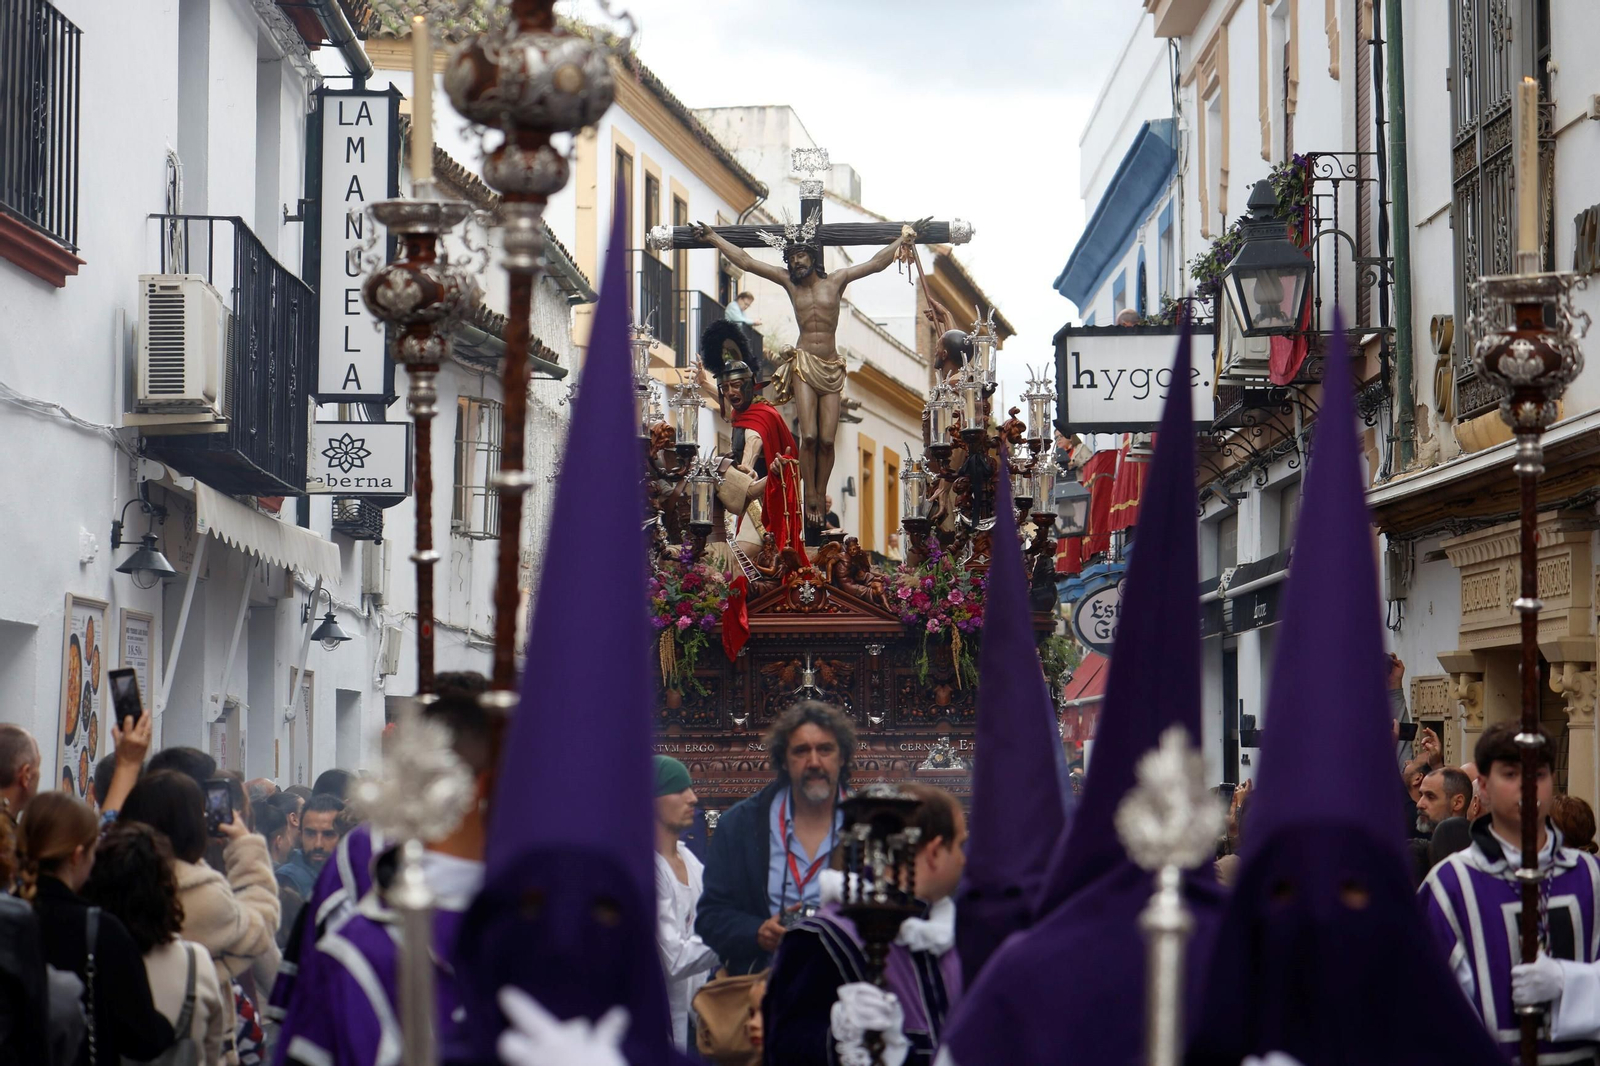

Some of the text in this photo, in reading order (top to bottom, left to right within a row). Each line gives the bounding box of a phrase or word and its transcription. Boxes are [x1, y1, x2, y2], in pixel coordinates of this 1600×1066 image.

[338, 101, 373, 126] LA
[342, 136, 365, 390] MANUELA
[315, 473, 393, 488] aberna
[1090, 600, 1122, 619] Est
[651, 744, 679, 752] NTVM
[685, 744, 715, 752] ERGO
[748, 743, 766, 751] SAC
[900, 743, 934, 751] CERN
